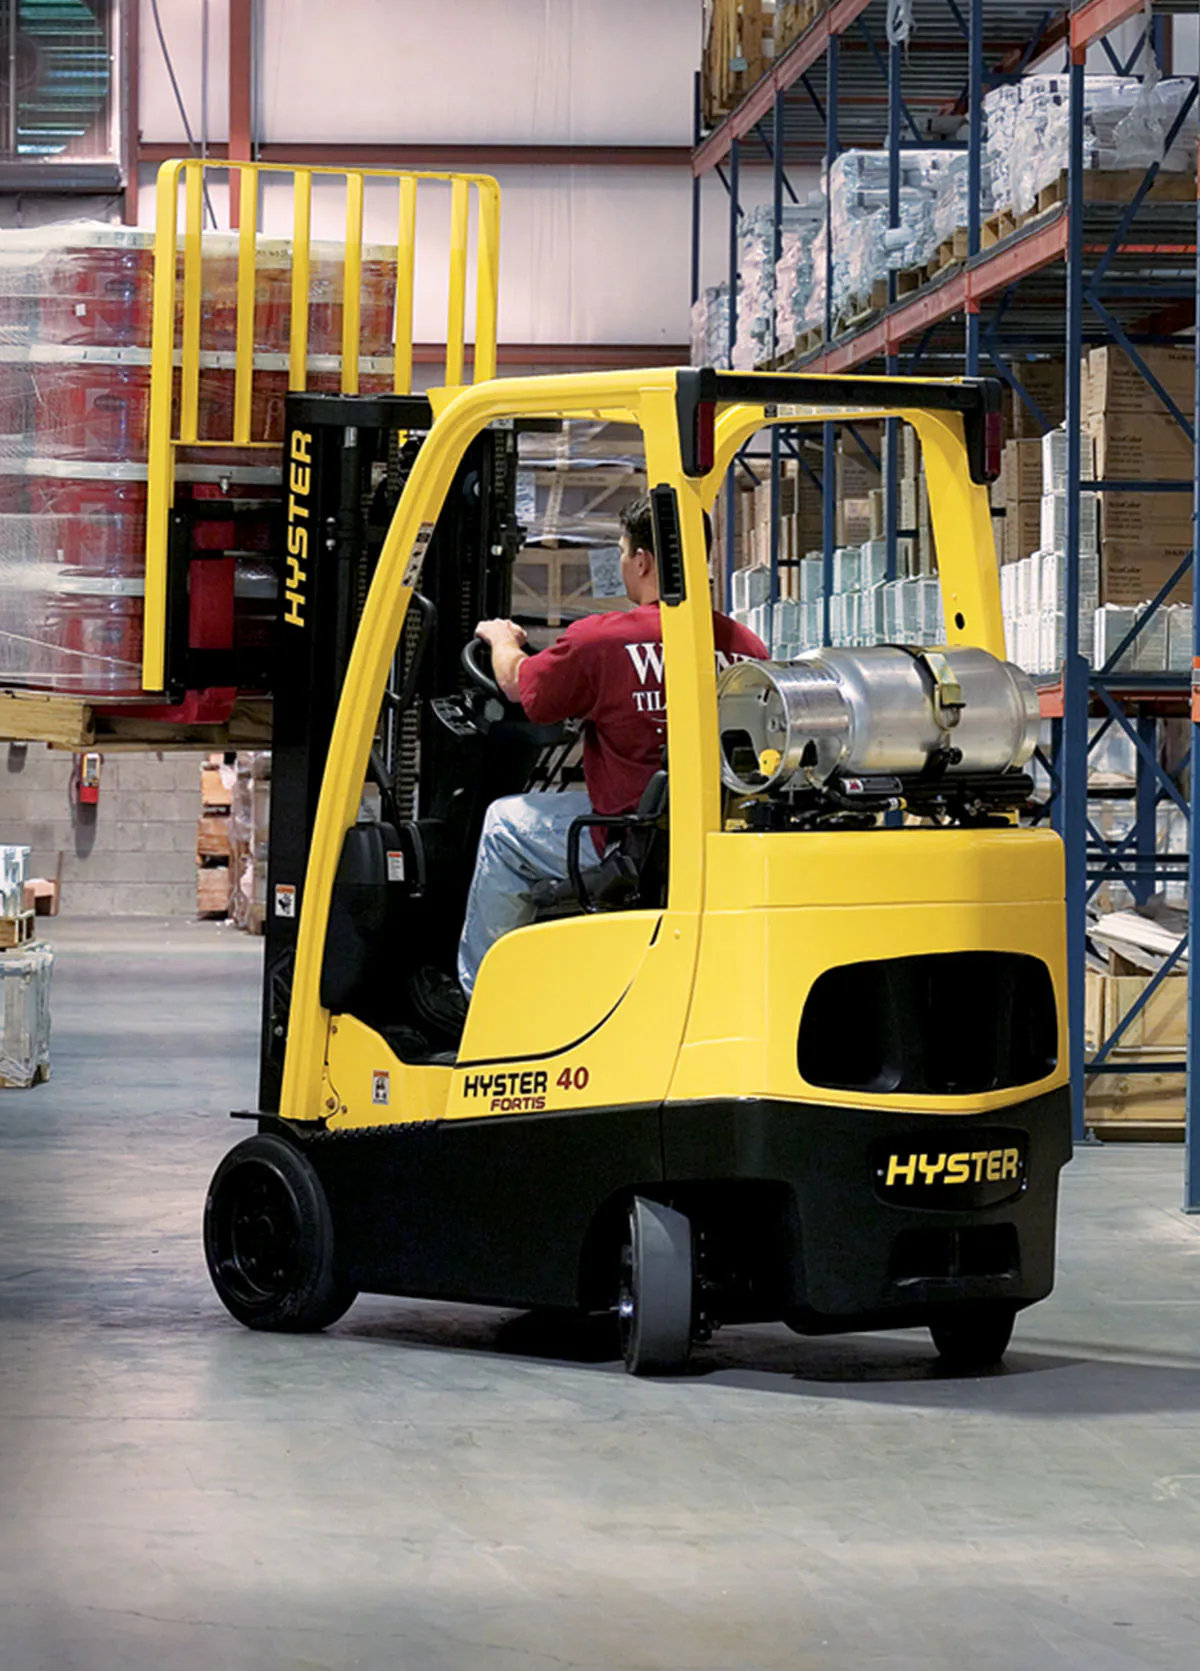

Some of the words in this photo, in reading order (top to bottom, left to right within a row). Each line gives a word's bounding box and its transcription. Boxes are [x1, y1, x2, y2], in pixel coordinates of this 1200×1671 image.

[284, 429, 312, 627] HYSTER
[464, 1072, 547, 1097] HYSTER
[556, 1066, 589, 1090] 40
[490, 1097, 546, 1111] FORTIS
[885, 1149, 1018, 1186] HYSTER
